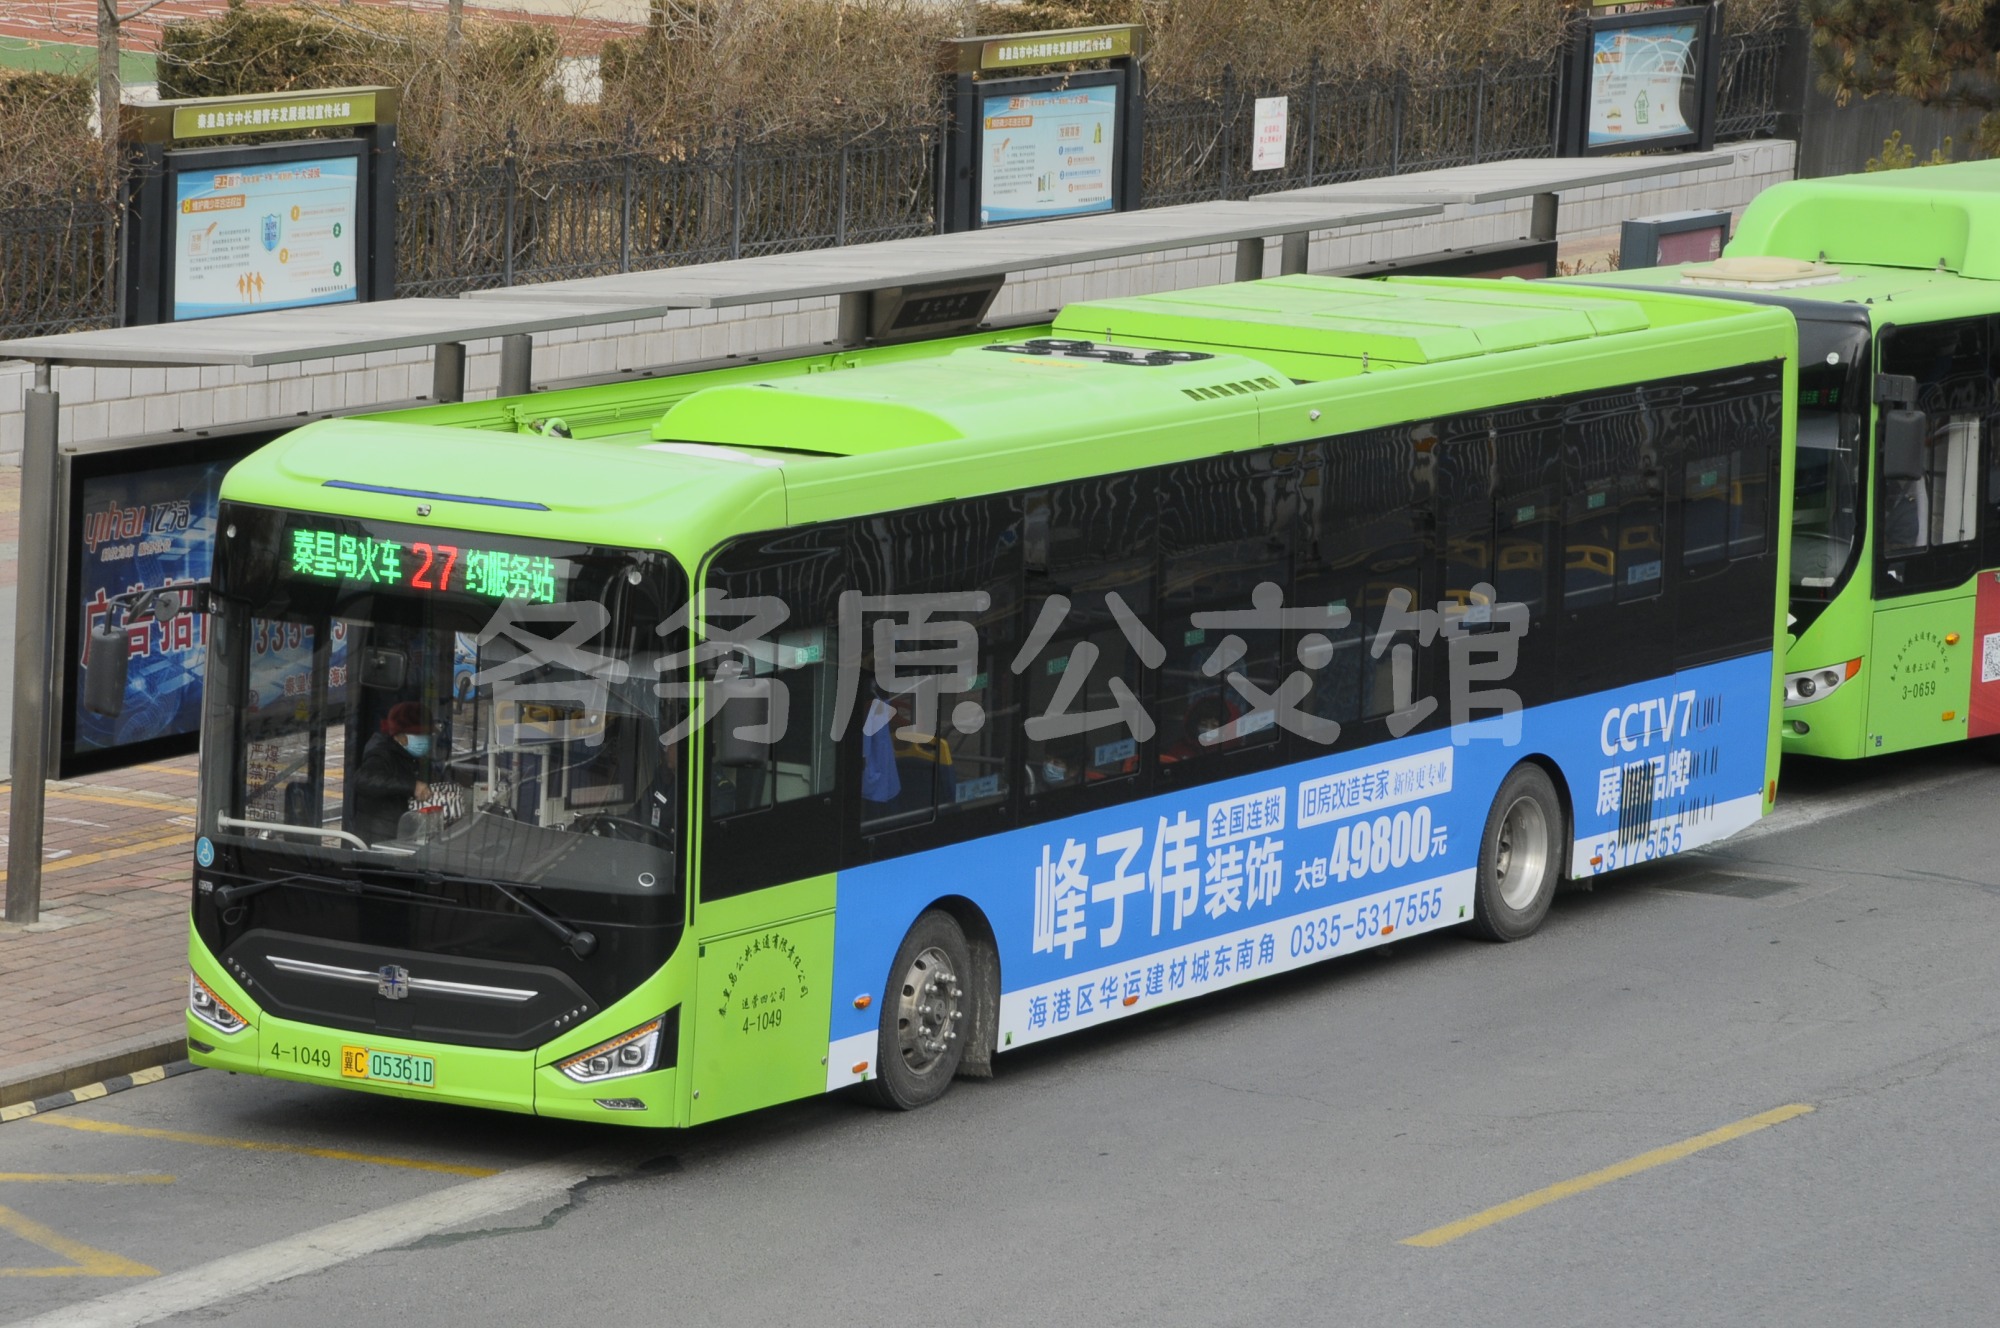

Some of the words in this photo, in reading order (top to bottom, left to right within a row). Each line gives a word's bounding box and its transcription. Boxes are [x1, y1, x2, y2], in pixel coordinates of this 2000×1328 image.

[197, 102, 351, 129] 秦皇岛市中长期青年发展规划宣传长廊
[411, 542, 458, 590] 27
[80, 577, 210, 669] 广告招
[1902, 680, 1936, 701] 3-0659
[1600, 689, 1696, 757] CCTV7
[1302, 780, 1390, 820] 旧房改造专家
[1393, 761, 1448, 796] 新房更专业
[1211, 796, 1281, 838] 全国连锁
[1593, 823, 1683, 874] 5317555
[1032, 809, 1201, 960] 峰子伟
[1204, 836, 1285, 920] 装饰
[1027, 932, 1276, 1032] 海港区华运建材城东南角
[1290, 886, 1444, 958] 0335-5317555
[742, 987, 786, 1010] 运营四公司
[742, 1009, 782, 1035] 4-1049
[271, 1042, 331, 1068] 4-1049
